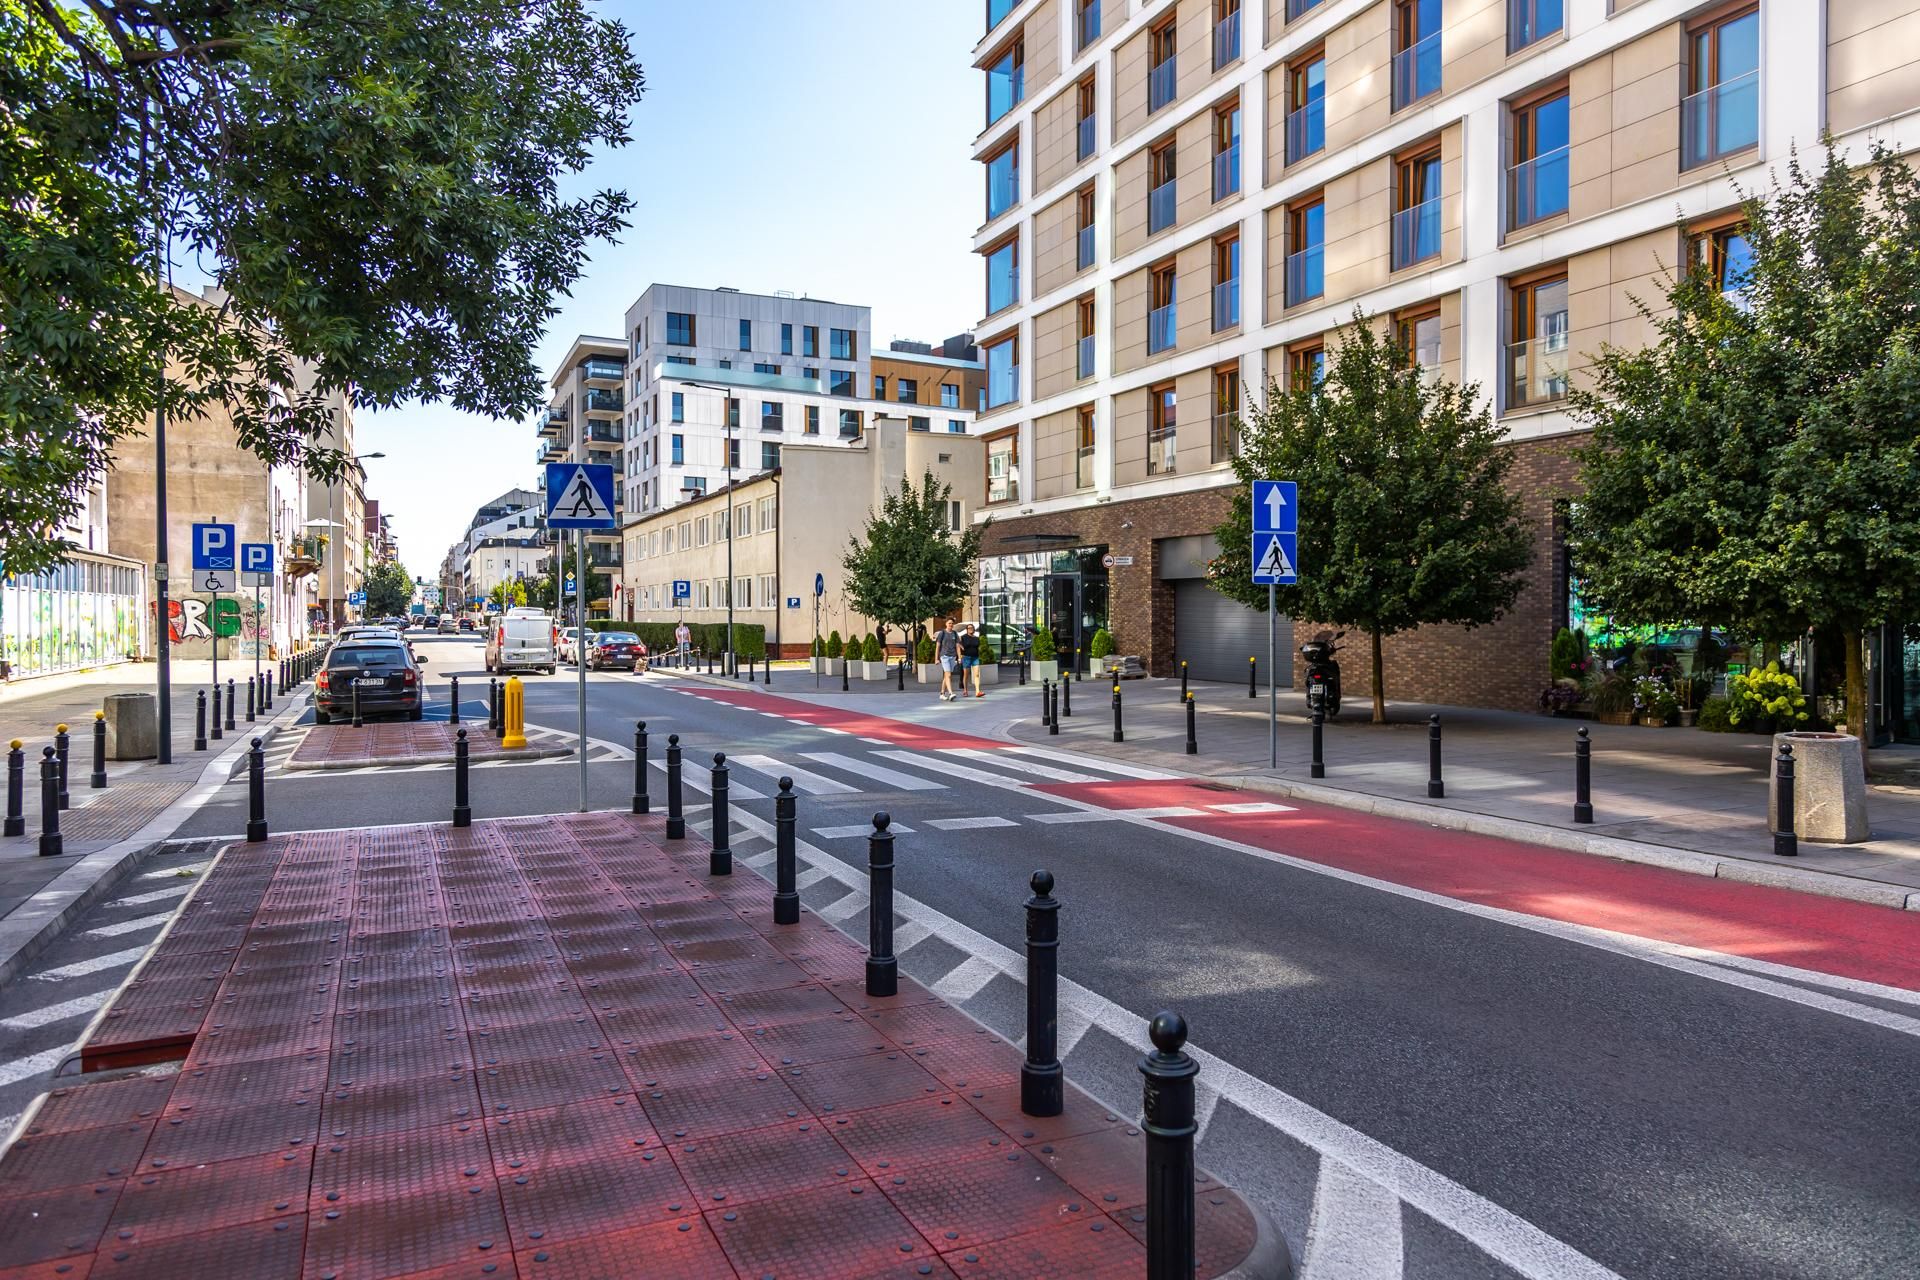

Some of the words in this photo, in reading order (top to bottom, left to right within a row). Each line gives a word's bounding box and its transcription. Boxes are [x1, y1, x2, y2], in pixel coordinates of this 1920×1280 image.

[202, 527, 226, 556] P
[248, 546, 267, 568] P
[351, 593, 358, 601] P
[676, 582, 687, 596] P
